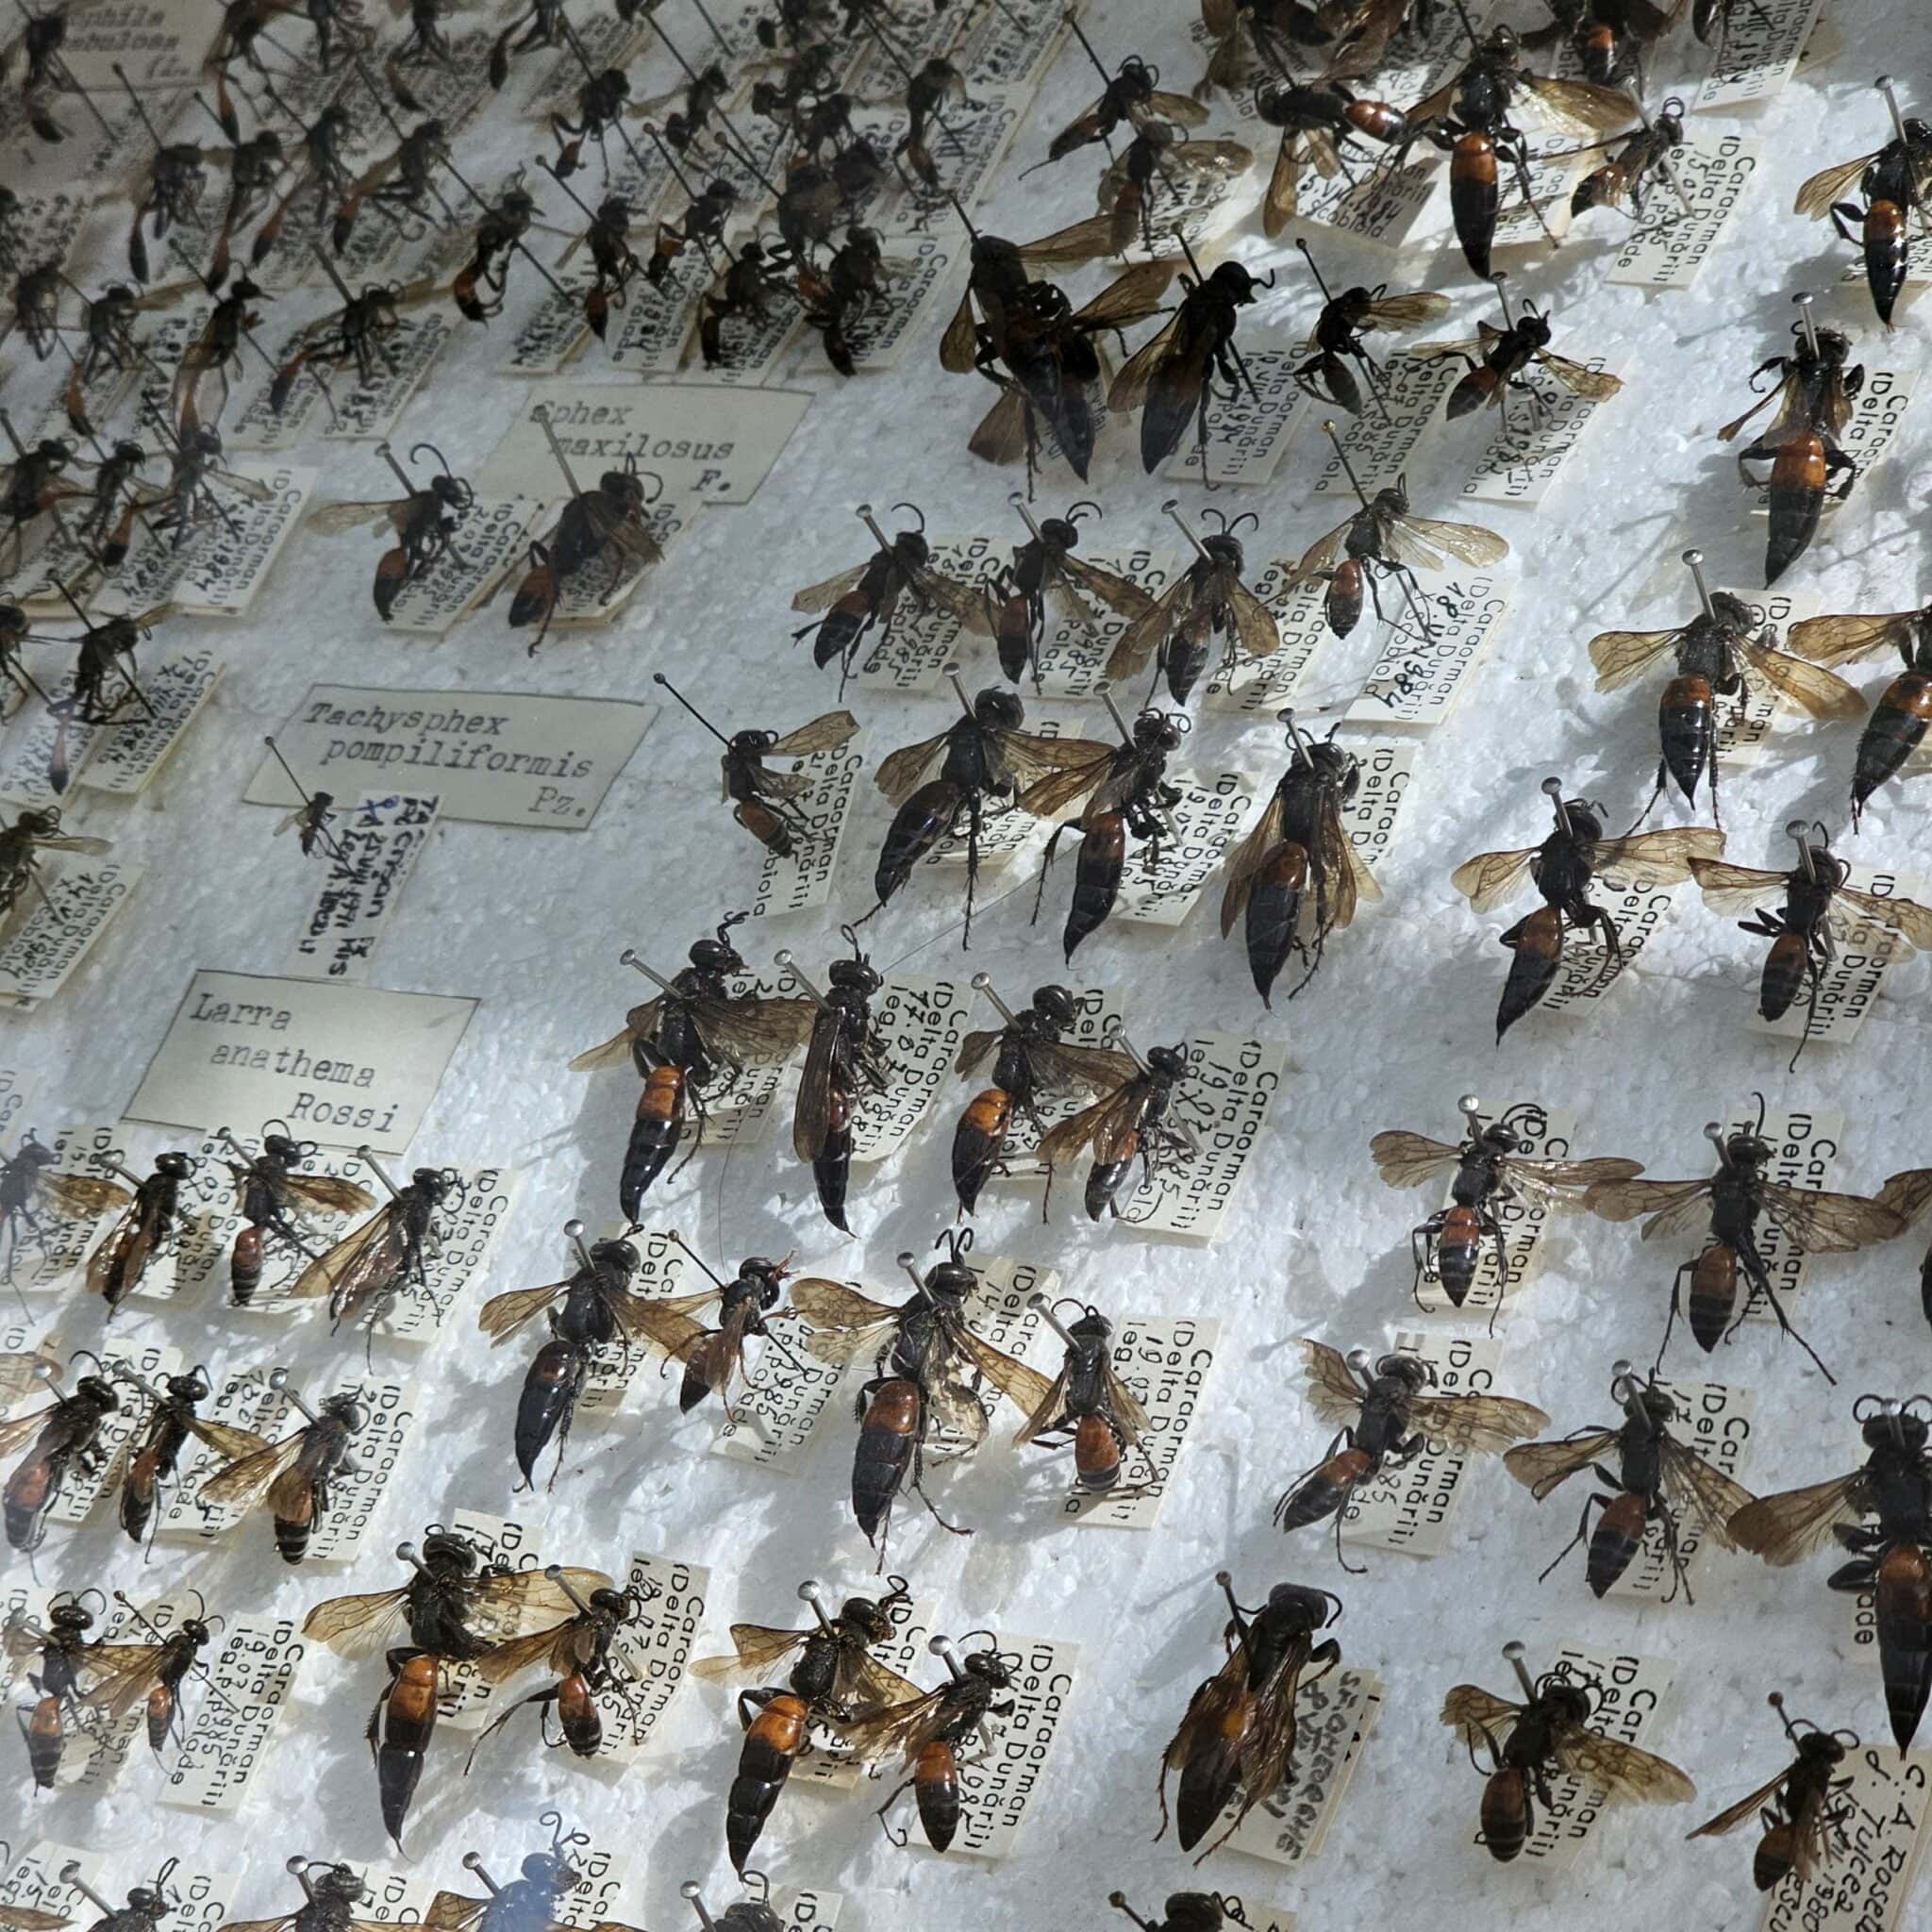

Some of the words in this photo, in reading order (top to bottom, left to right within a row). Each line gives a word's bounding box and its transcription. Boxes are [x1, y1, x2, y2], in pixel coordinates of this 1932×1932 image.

[1693, 135, 1743, 199] (Delta
[1651, 208, 1710, 282] Dunării)
[1684, 156, 1758, 265] Caraorman
[1220, 402, 1278, 475] Dunării)
[1383, 367, 1459, 474] Caraorman
[1844, 372, 1896, 440] (Delta
[691, 469, 733, 493] F.
[1442, 575, 1493, 637] (Delta
[894, 608, 955, 687] Dunării)
[1061, 622, 1124, 695] Dunării)
[1394, 644, 1457, 720] Dunării)
[1428, 598, 1507, 706] Caraorman
[304, 701, 508, 737] Tachysphex
[320, 734, 594, 779] pompiliformis
[528, 786, 585, 819] Pz.
[1188, 774, 1242, 838] (Delta
[1356, 747, 1395, 820] (Delta
[1133, 847, 1203, 916] Dunării)
[42, 882, 131, 979] Caraorman
[191, 991, 292, 1031] Larra
[910, 981, 957, 1059] (Delta
[1804, 953, 1868, 1036] Dunării)
[209, 1042, 376, 1089] anathema
[888, 1009, 973, 1138] Caraorman
[1216, 1039, 1266, 1123] (Delta
[287, 1091, 400, 1134] Rossi
[852, 1068, 924, 1154] Dunării)
[1206, 1071, 1280, 1211] Caraorman
[448, 1169, 502, 1240] (Delta
[1170, 1132, 1233, 1229] Dunării)
[395, 1250, 464, 1332] Dunării)
[430, 1194, 511, 1318] Caraorman
[984, 1264, 1040, 1344] (Delta
[1149, 1320, 1201, 1402] (Delta
[358, 1385, 401, 1458] (Delta
[753, 1367, 823, 1463] Dunării)
[1145, 1348, 1215, 1498] Caraorman
[311, 1469, 372, 1558] Dunării)
[344, 1411, 413, 1540] Caraorman
[653, 1562, 691, 1649] (Delta
[250, 1619, 294, 1695] (Delta
[634, 1595, 708, 1740] Caraorman
[1006, 1643, 1057, 1731] (Delta
[232, 1644, 305, 1784] Caraorman
[1000, 1672, 1074, 1827] Caraorman
[200, 1705, 261, 1807] Dunării)
[963, 1740, 1026, 1849] Dunării)
